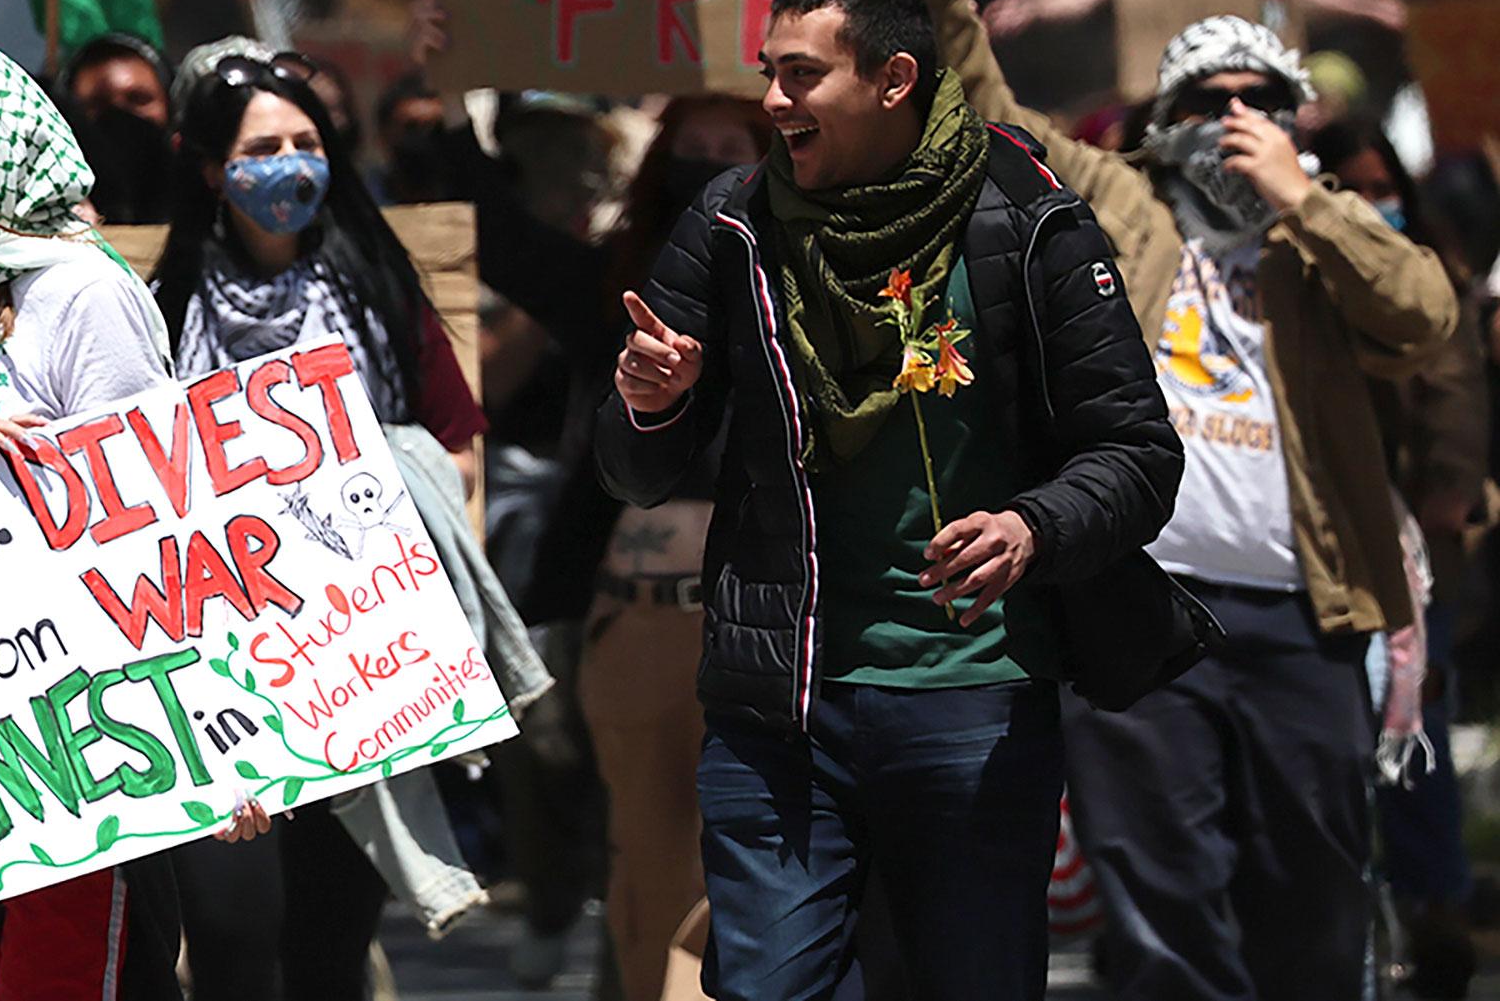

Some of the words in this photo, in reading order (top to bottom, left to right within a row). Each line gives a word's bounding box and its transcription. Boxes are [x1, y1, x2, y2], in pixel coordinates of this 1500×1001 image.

[9, 342, 362, 552] DIVEST
[79, 514, 306, 652] WAR
[250, 536, 440, 688] Students
[192, 707, 260, 754] in
[286, 630, 431, 731] Workers
[324, 645, 493, 775] Communities
